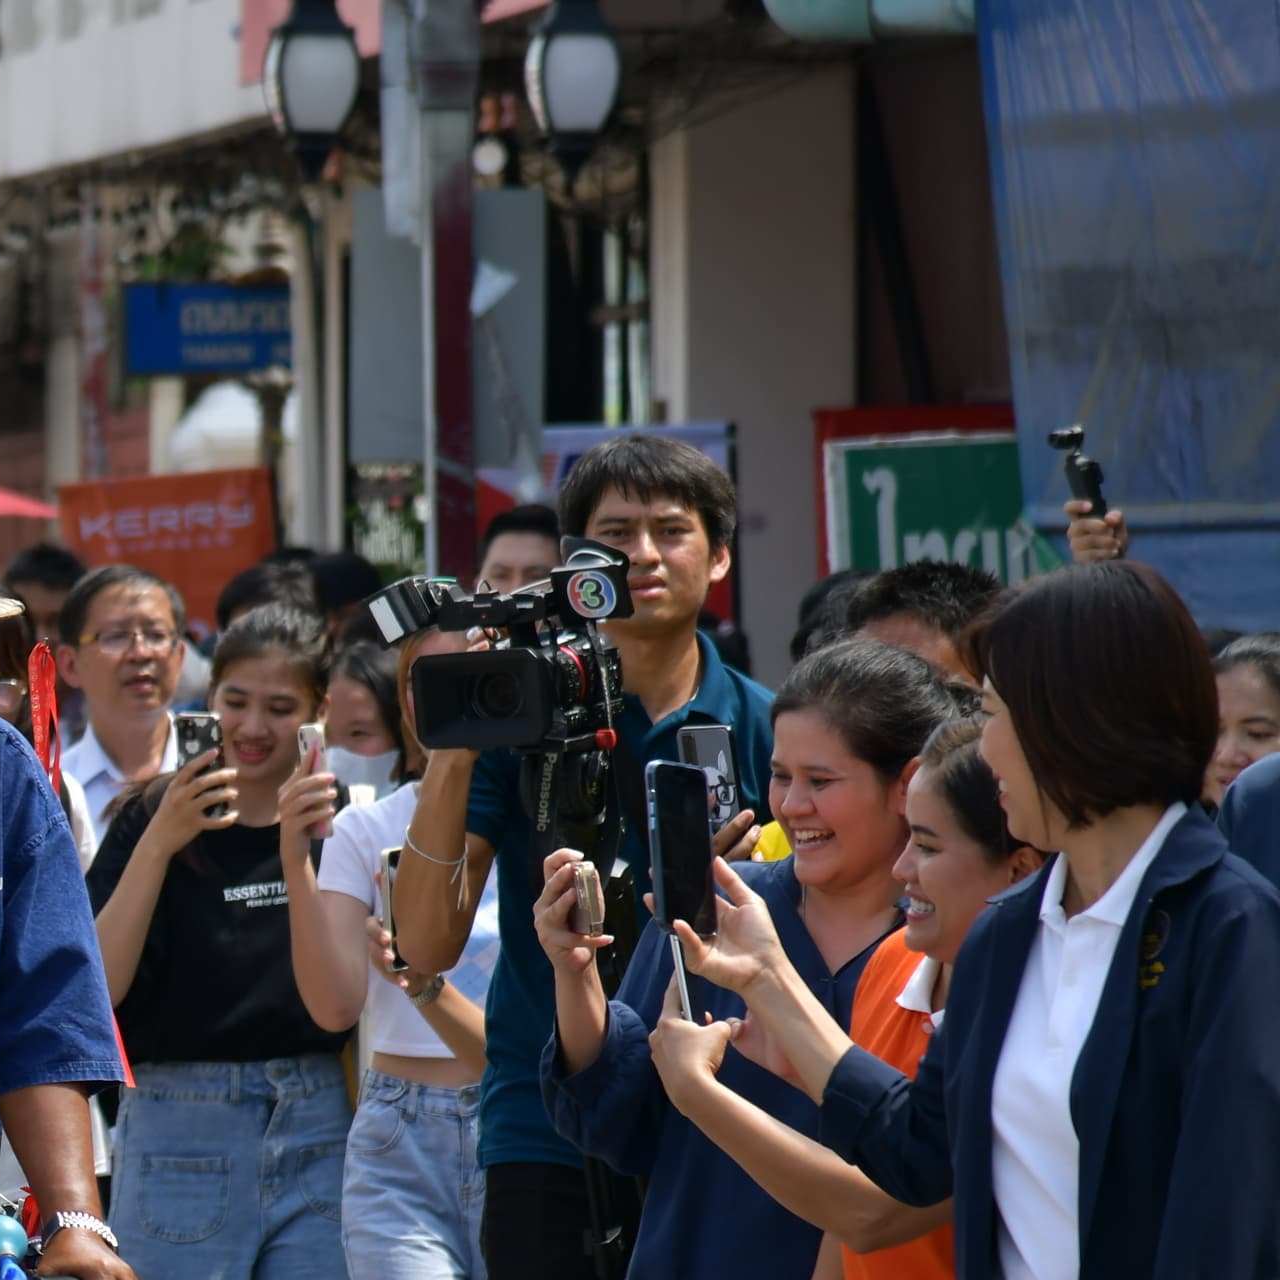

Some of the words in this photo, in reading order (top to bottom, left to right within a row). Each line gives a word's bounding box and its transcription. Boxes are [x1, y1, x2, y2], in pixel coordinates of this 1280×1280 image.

[79, 498, 254, 540] KERRY
[537, 752, 559, 832] Panasonic
[223, 881, 289, 902] ESSENTIA
